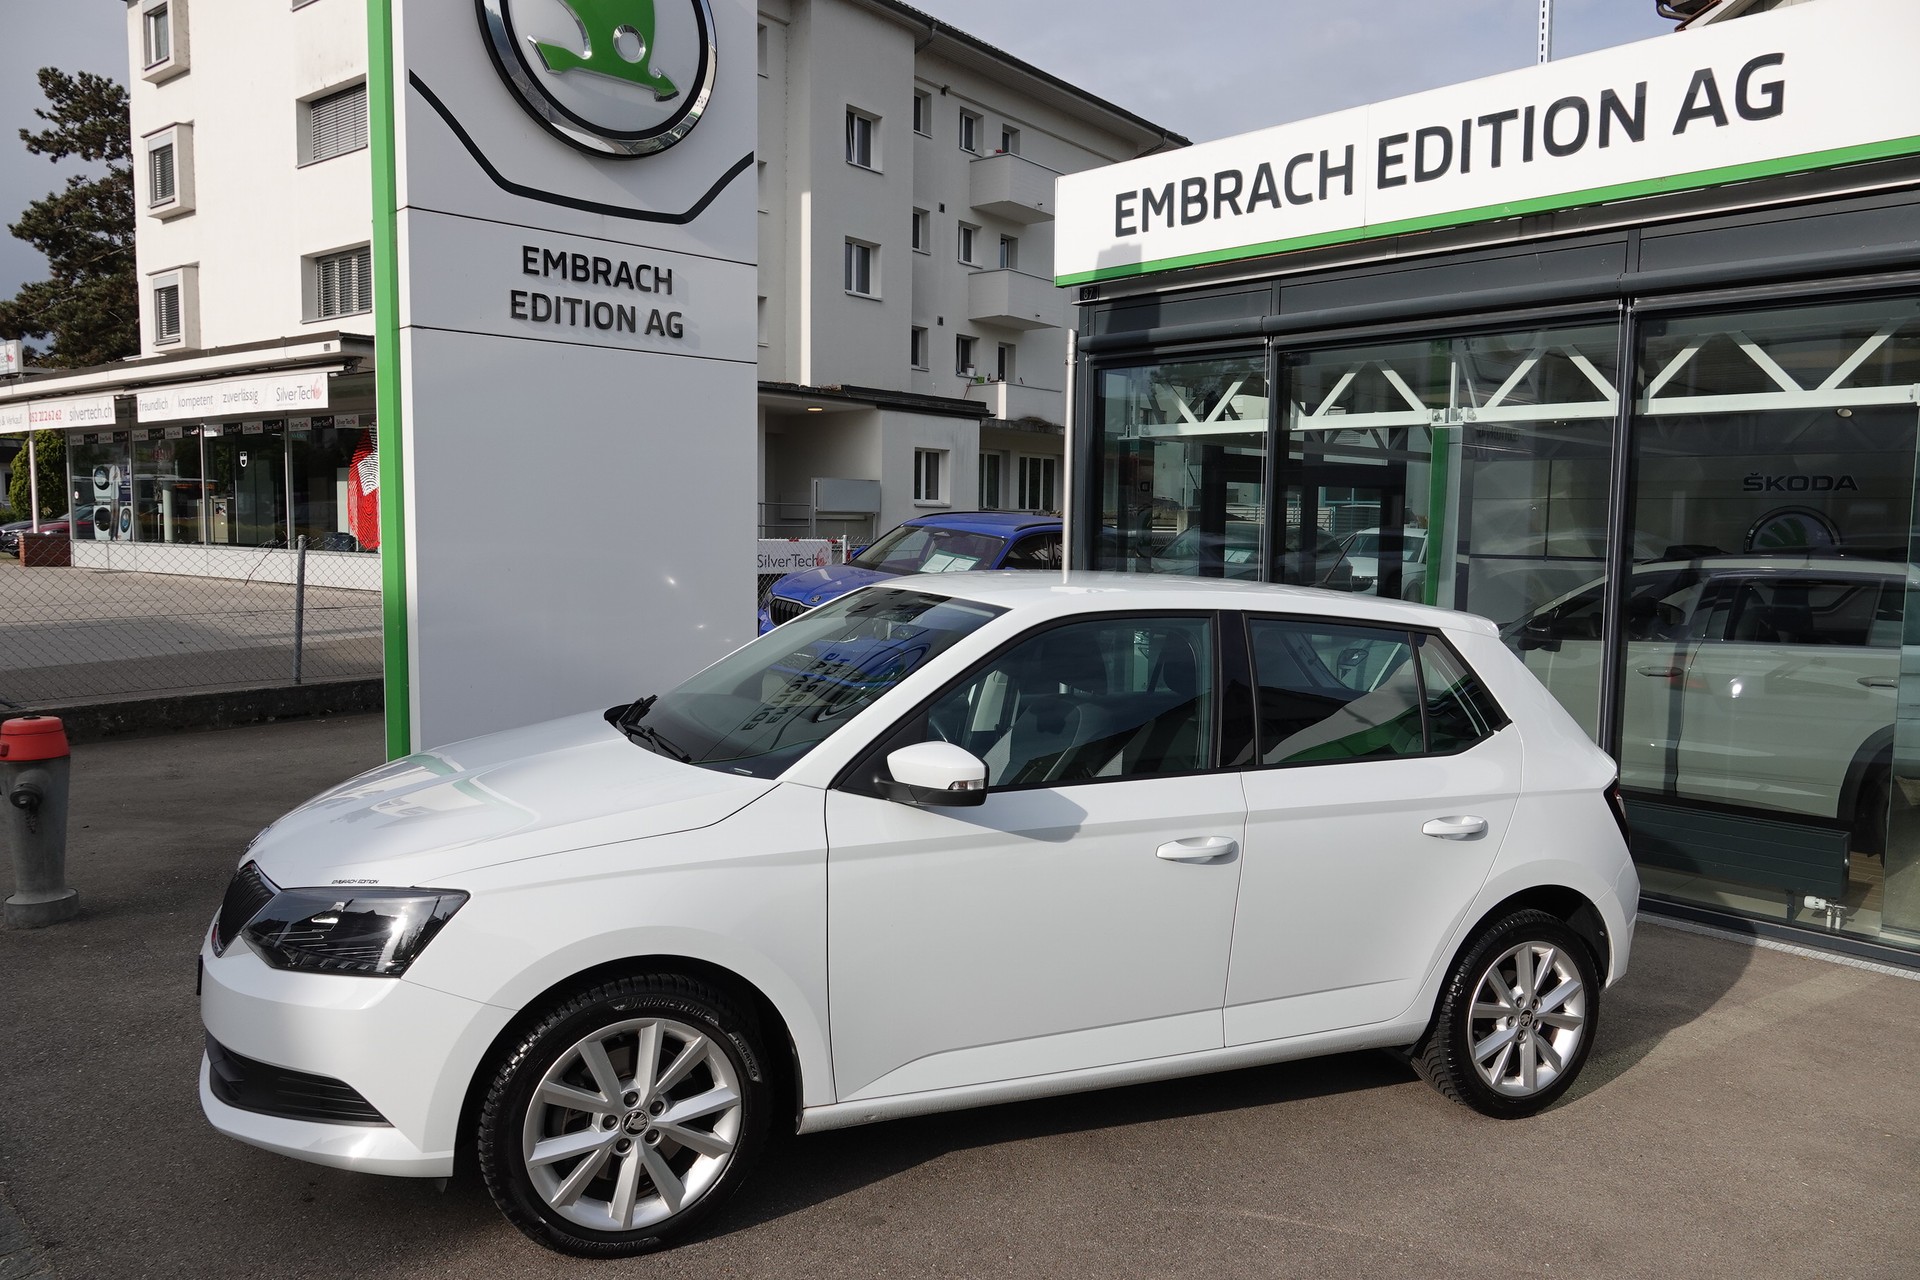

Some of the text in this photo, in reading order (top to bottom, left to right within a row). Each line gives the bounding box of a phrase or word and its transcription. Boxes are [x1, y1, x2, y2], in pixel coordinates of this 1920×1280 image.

[1115, 52, 1785, 238] EMBRACH EDITION AG
[522, 245, 673, 296] EMBRACH
[510, 289, 684, 339] EDITION AG
[69, 401, 113, 422] silvertech.ch
[178, 394, 213, 410] kompetent
[276, 385, 315, 402] SilverTech
[1743, 472, 1858, 492] ŠKODA
[757, 553, 818, 568] SilverTech
[734, 1034, 759, 1078] TURANZA
